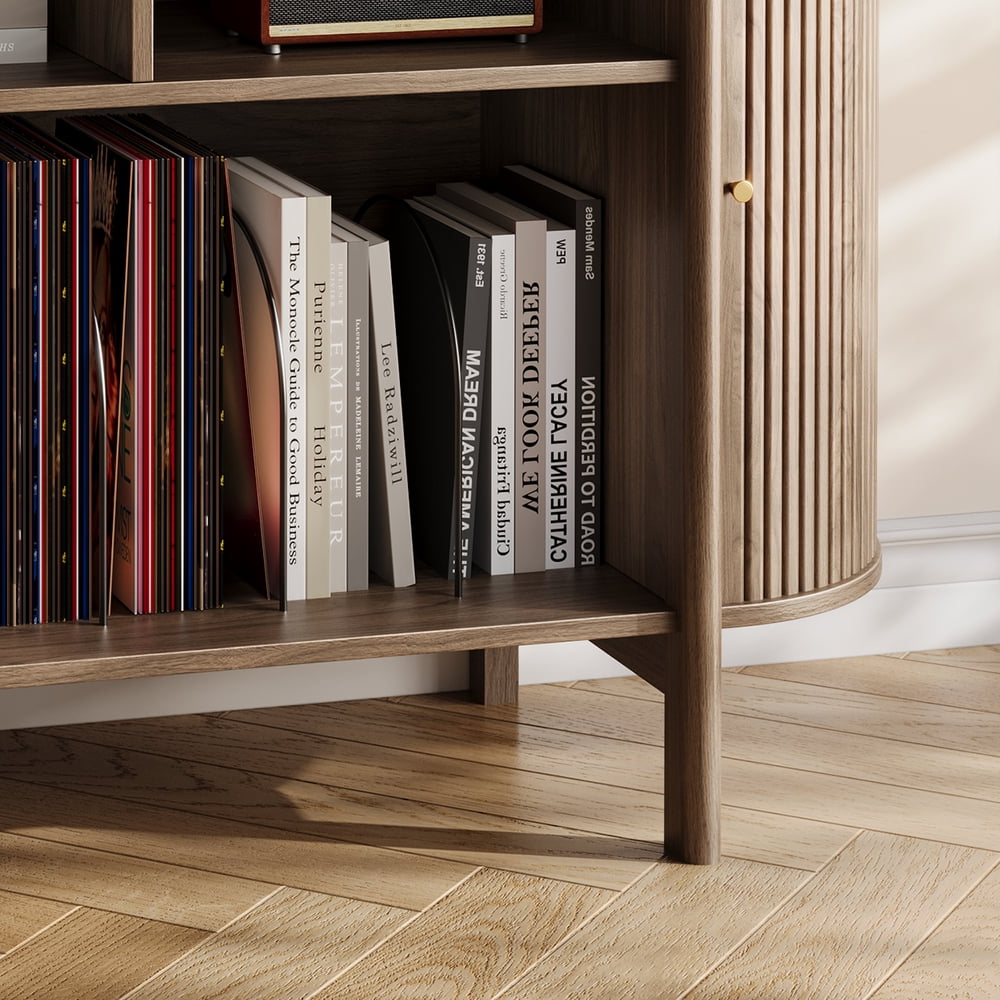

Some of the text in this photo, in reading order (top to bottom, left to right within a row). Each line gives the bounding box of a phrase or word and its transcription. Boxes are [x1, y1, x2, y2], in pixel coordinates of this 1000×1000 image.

[289, 236, 301, 565] The Monocle Guide to Good Business
[310, 281, 326, 506] Purienne Holiday
[381, 342, 403, 485] Lee Radziwill
